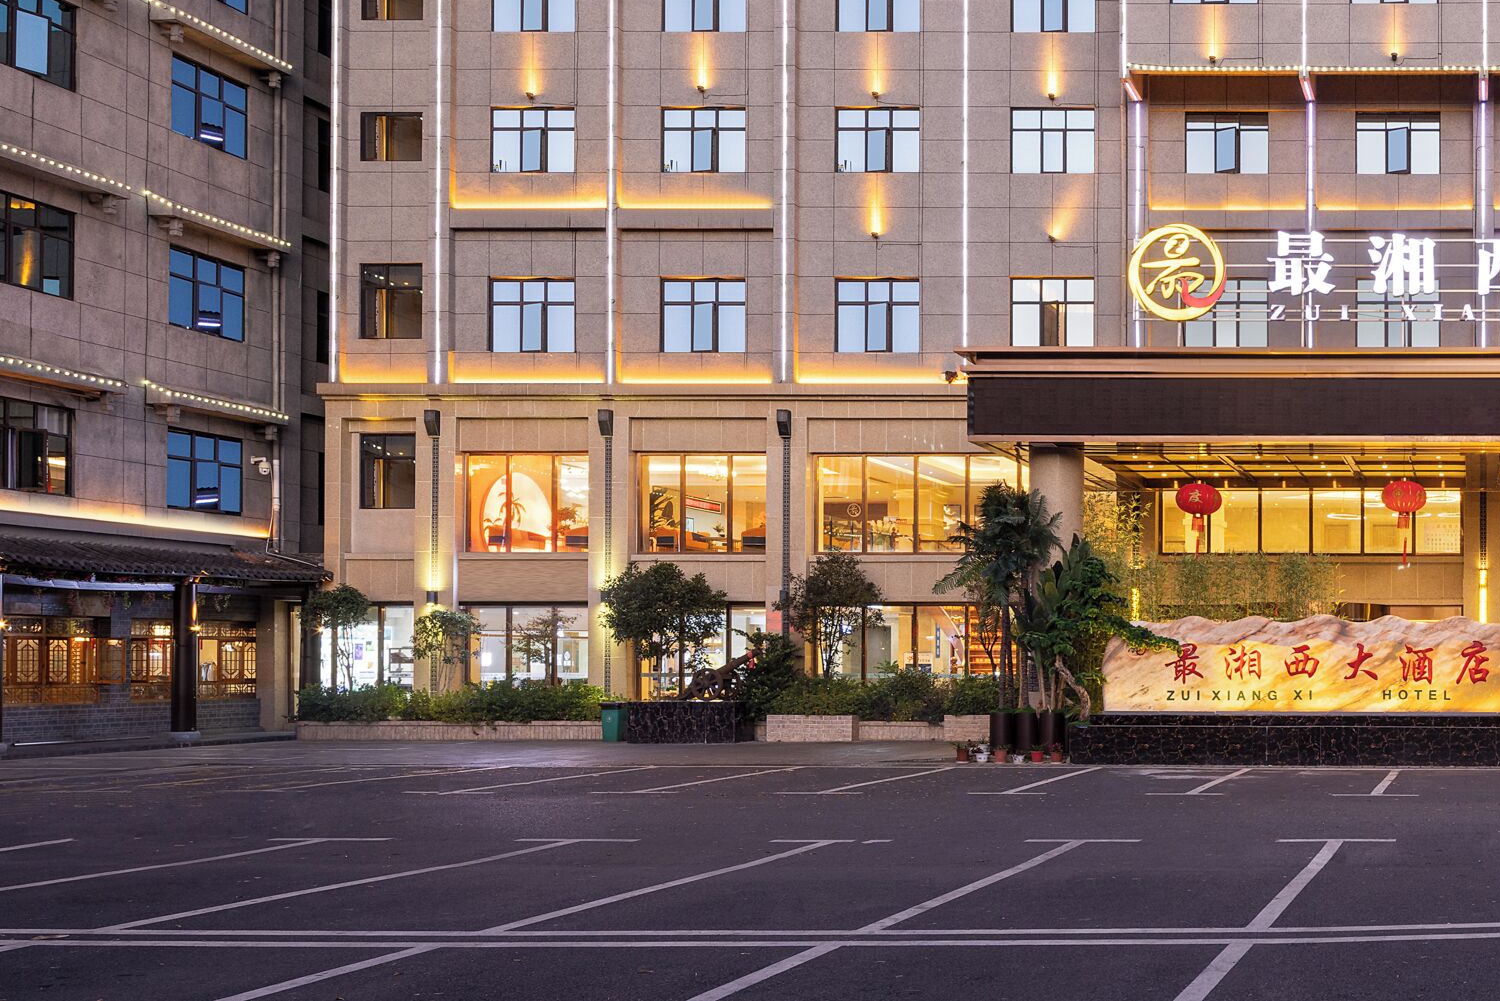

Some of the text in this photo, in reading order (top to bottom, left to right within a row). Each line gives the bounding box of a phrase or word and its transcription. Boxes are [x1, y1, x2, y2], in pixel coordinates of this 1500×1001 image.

[1269, 304, 1350, 321] ZUI
[1165, 640, 1490, 685] 最湘西大酒店
[1166, 689, 1451, 701] ZUI XIANG XI HOTEL
